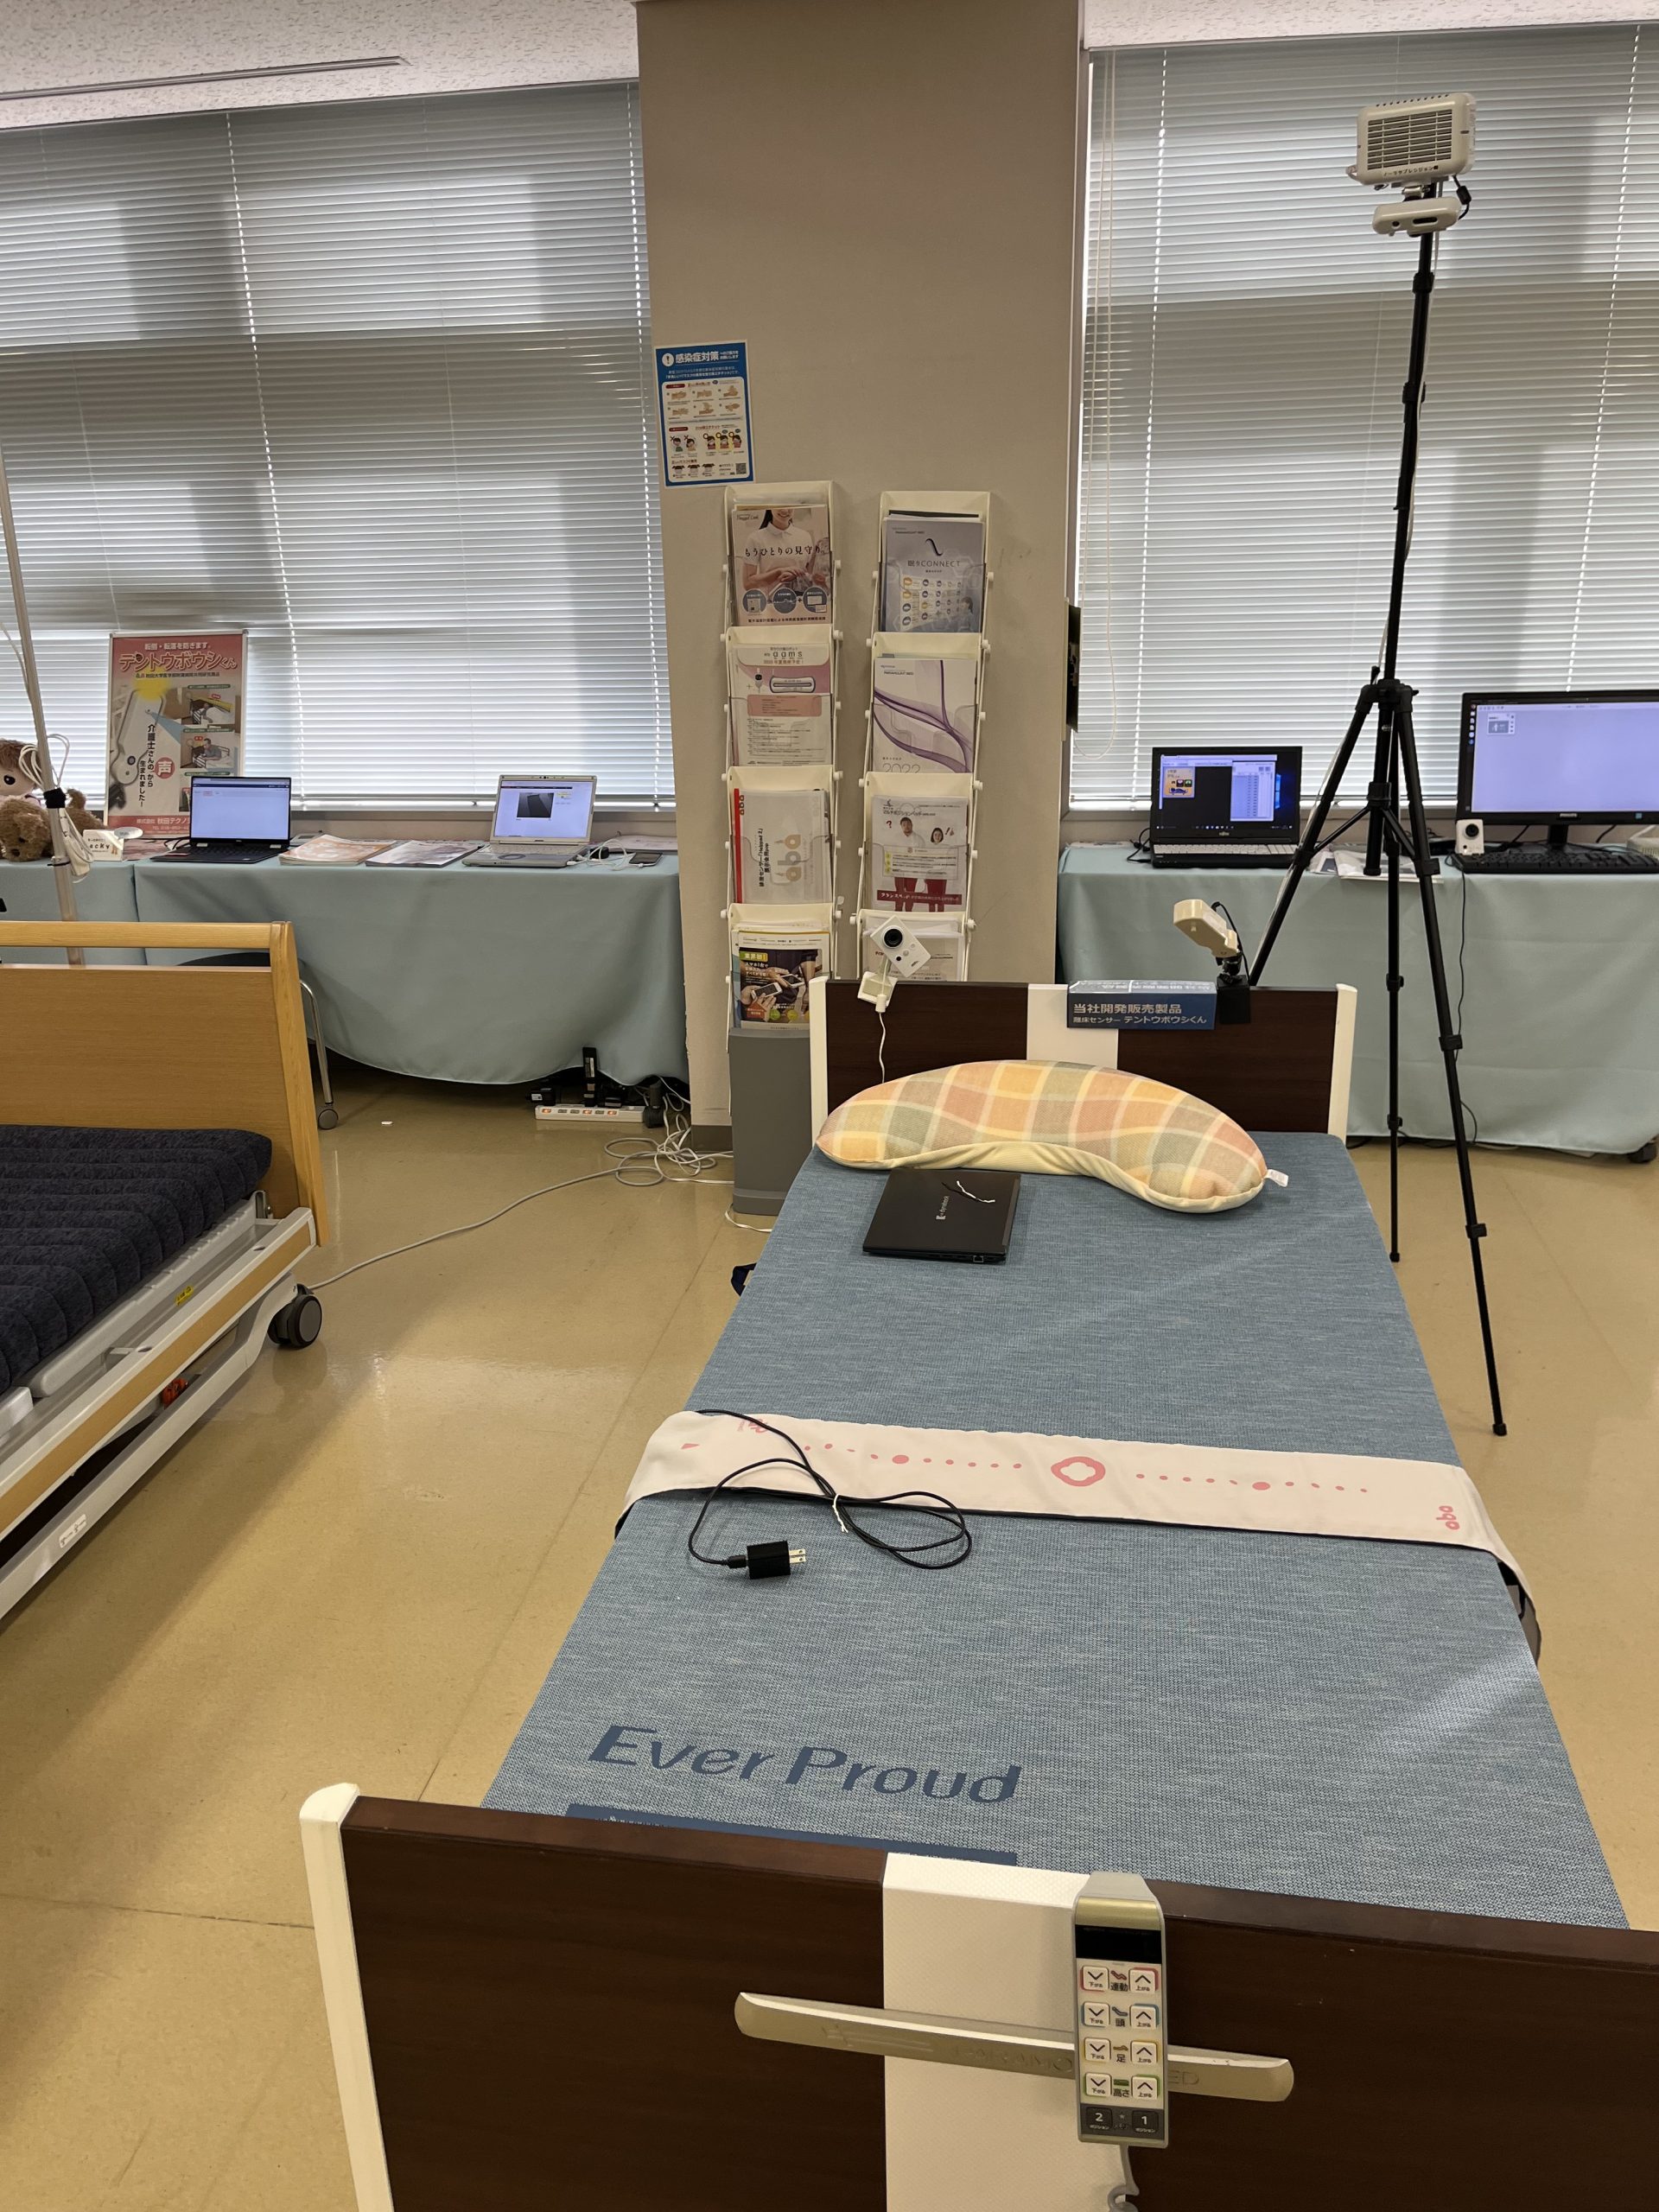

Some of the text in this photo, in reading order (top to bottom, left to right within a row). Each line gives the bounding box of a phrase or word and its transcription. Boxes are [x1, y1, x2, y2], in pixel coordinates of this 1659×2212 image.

[675, 351, 719, 364] 感染症対策
[157, 760, 173, 776] 声
[1073, 1004, 1182, 1014] 当社開発販売製品
[1123, 1014, 1207, 1025] テントウボウシくん
[588, 1724, 1023, 1804] Ever Proud
[1115, 2018, 1126, 2027] 頭
[1116, 2054, 1126, 2063] 足
[1113, 2088, 1129, 2097] 高さ
[1095, 2113, 1104, 2122] 2
